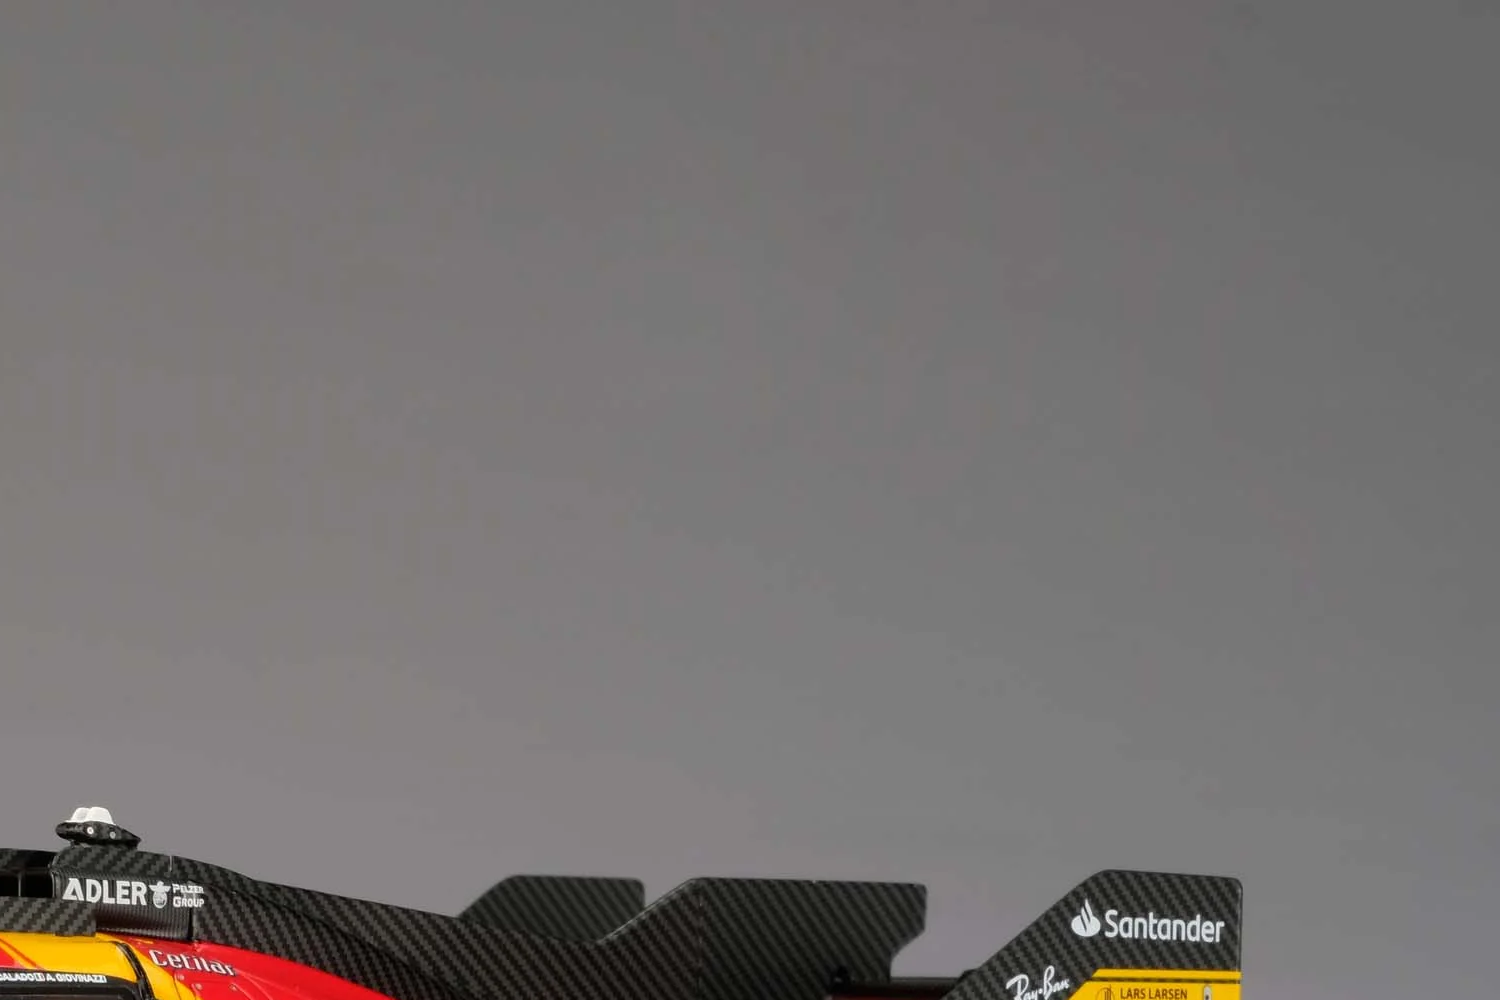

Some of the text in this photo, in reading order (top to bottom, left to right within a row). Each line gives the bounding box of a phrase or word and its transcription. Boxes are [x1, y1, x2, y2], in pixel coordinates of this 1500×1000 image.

[62, 878, 147, 906] ADLER
[172, 883, 205, 894] PELZER
[173, 897, 205, 908] GROUP
[1104, 909, 1225, 943] Santander
[148, 949, 235, 976] Cetilar
[1120, 988, 1188, 1000] LARS LARSEN
